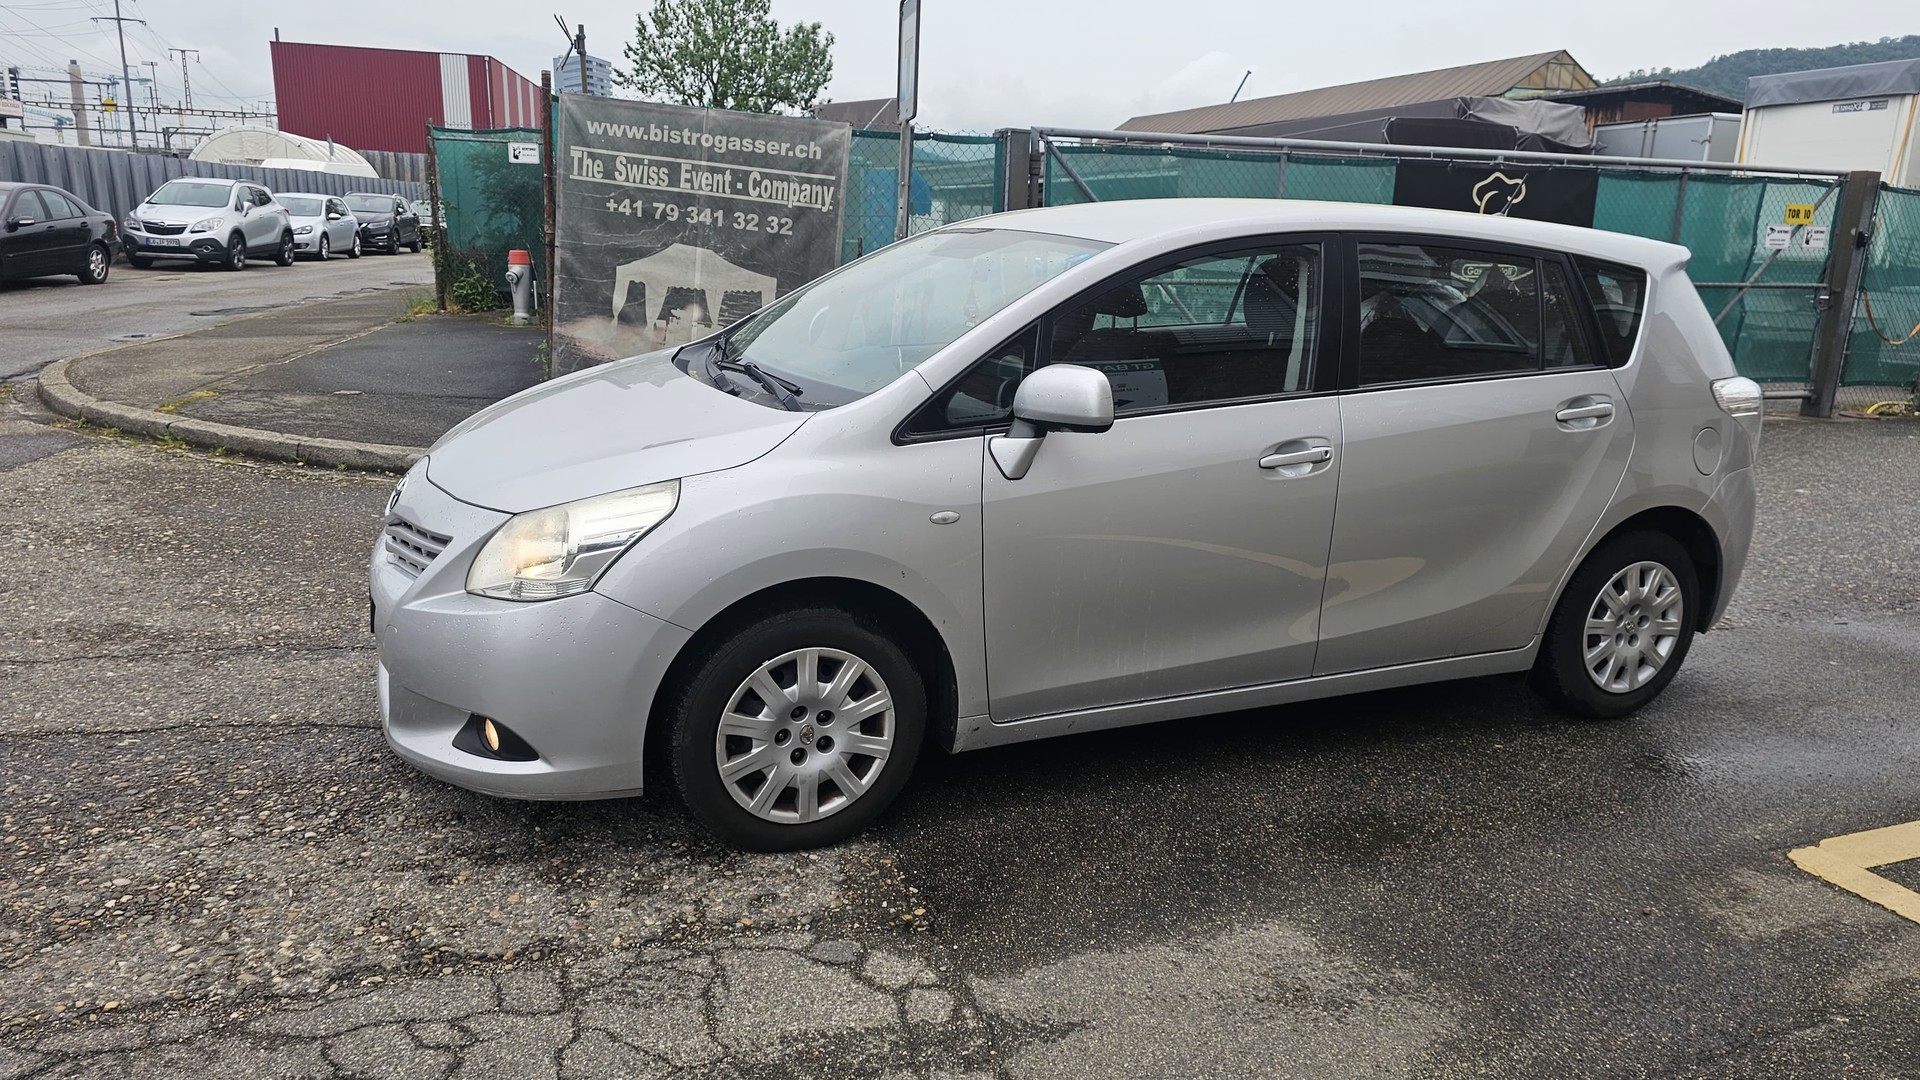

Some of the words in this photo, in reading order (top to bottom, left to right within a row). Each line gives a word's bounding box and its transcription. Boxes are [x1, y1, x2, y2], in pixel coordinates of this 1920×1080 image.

[587, 120, 821, 160] www.bistrogasser.ch
[570, 149, 604, 179] The
[614, 155, 669, 187] Swiss
[680, 162, 731, 194] Event
[606, 198, 643, 217] +41
[653, 202, 679, 221] 79
[686, 206, 724, 227] 341
[732, 211, 759, 231] 32
[766, 215, 793, 235] 32
[1787, 208, 1801, 219] TOR
